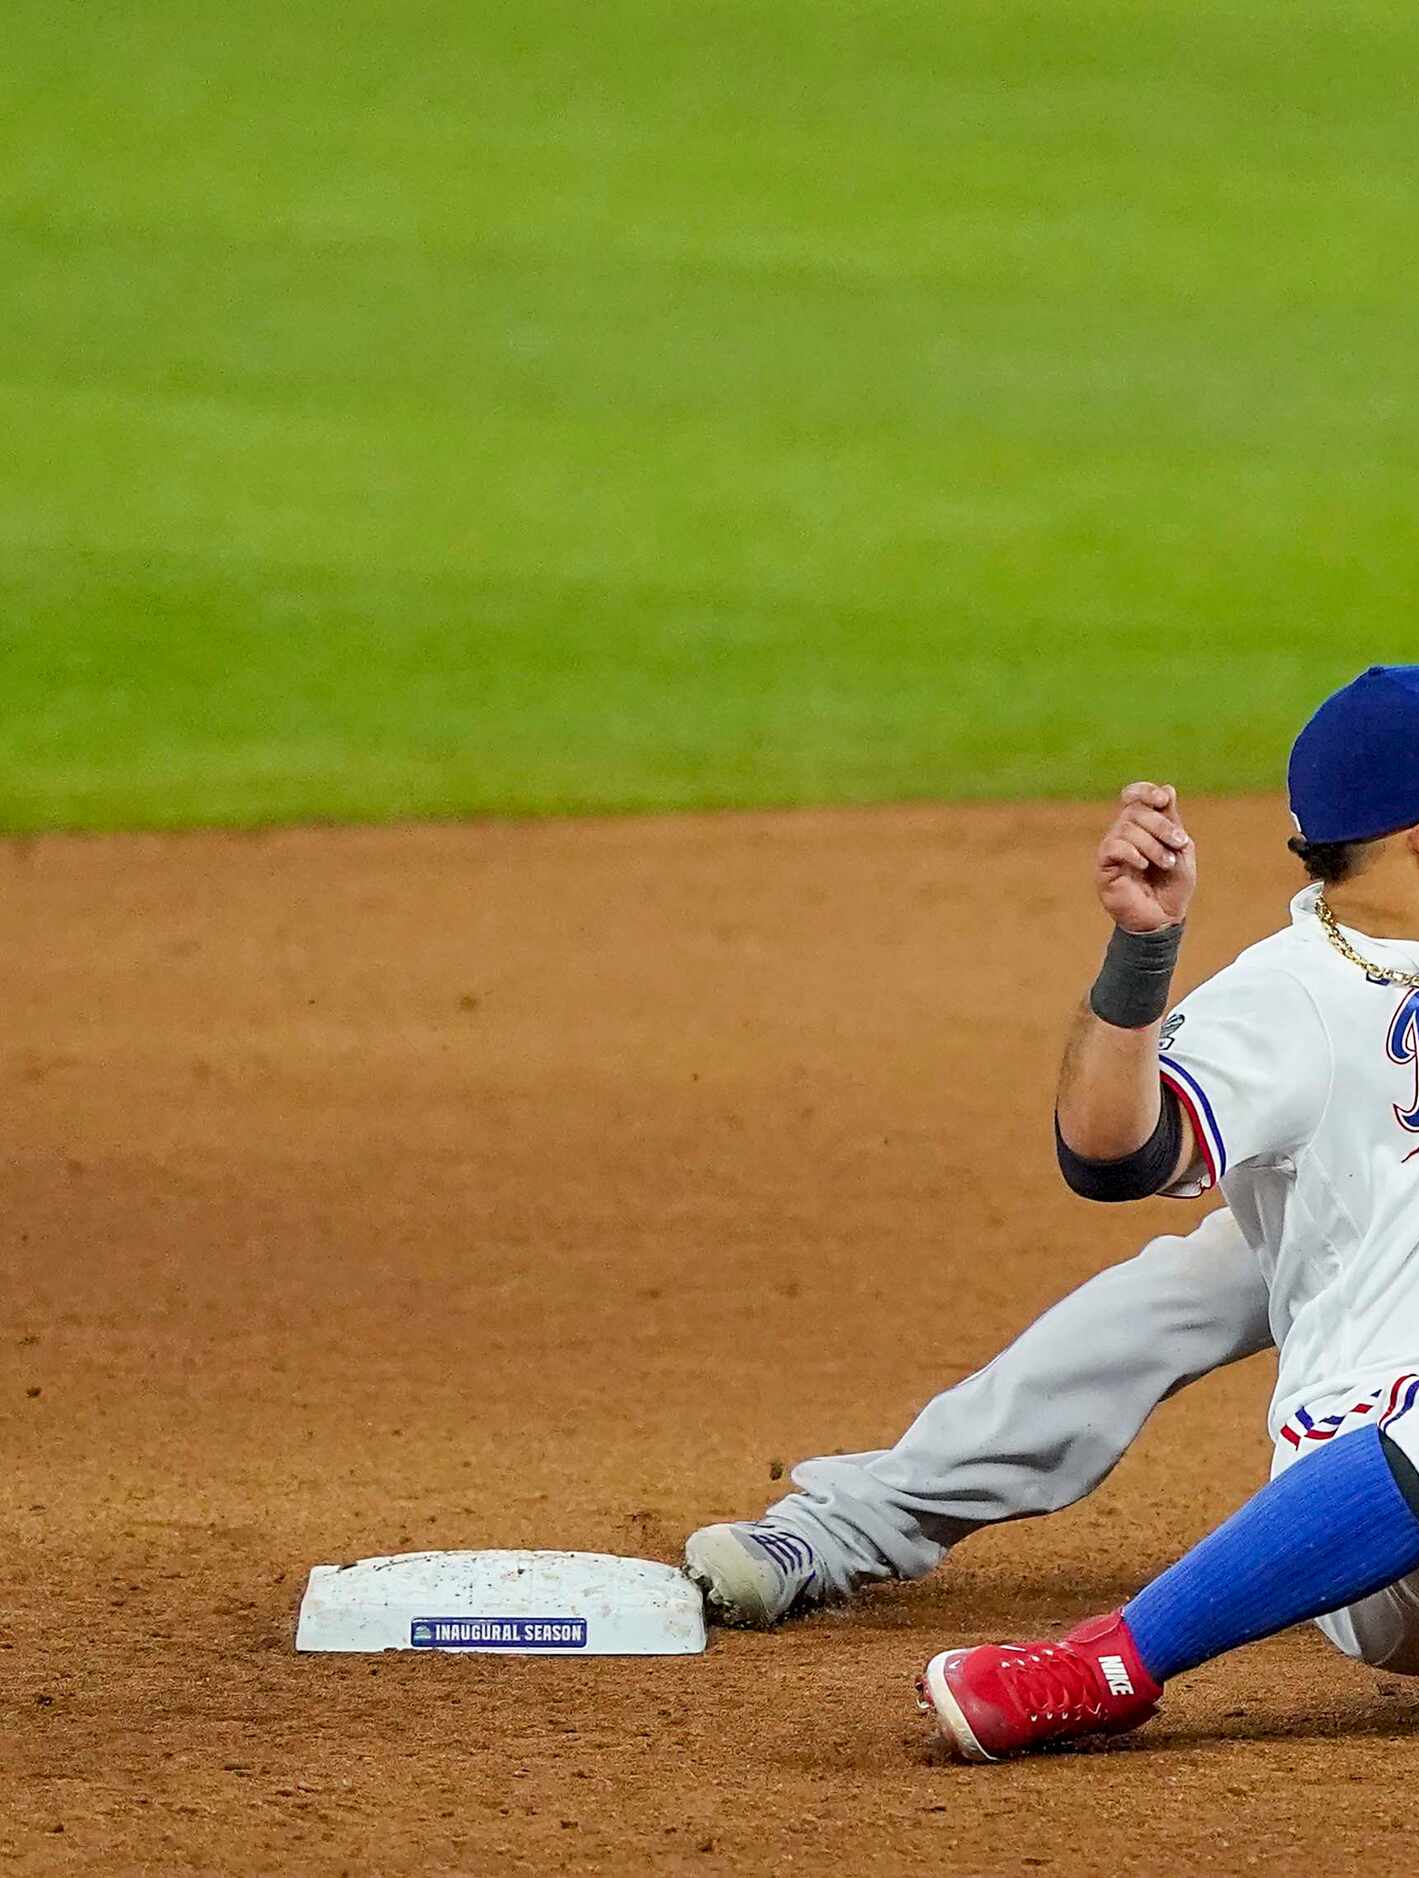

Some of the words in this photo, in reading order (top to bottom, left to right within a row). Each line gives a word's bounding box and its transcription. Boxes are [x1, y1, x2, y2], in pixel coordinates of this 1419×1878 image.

[435, 1624, 521, 1641] INAUGURAL
[524, 1624, 582, 1641] SEASON
[1098, 1655, 1135, 1697] NIKE
